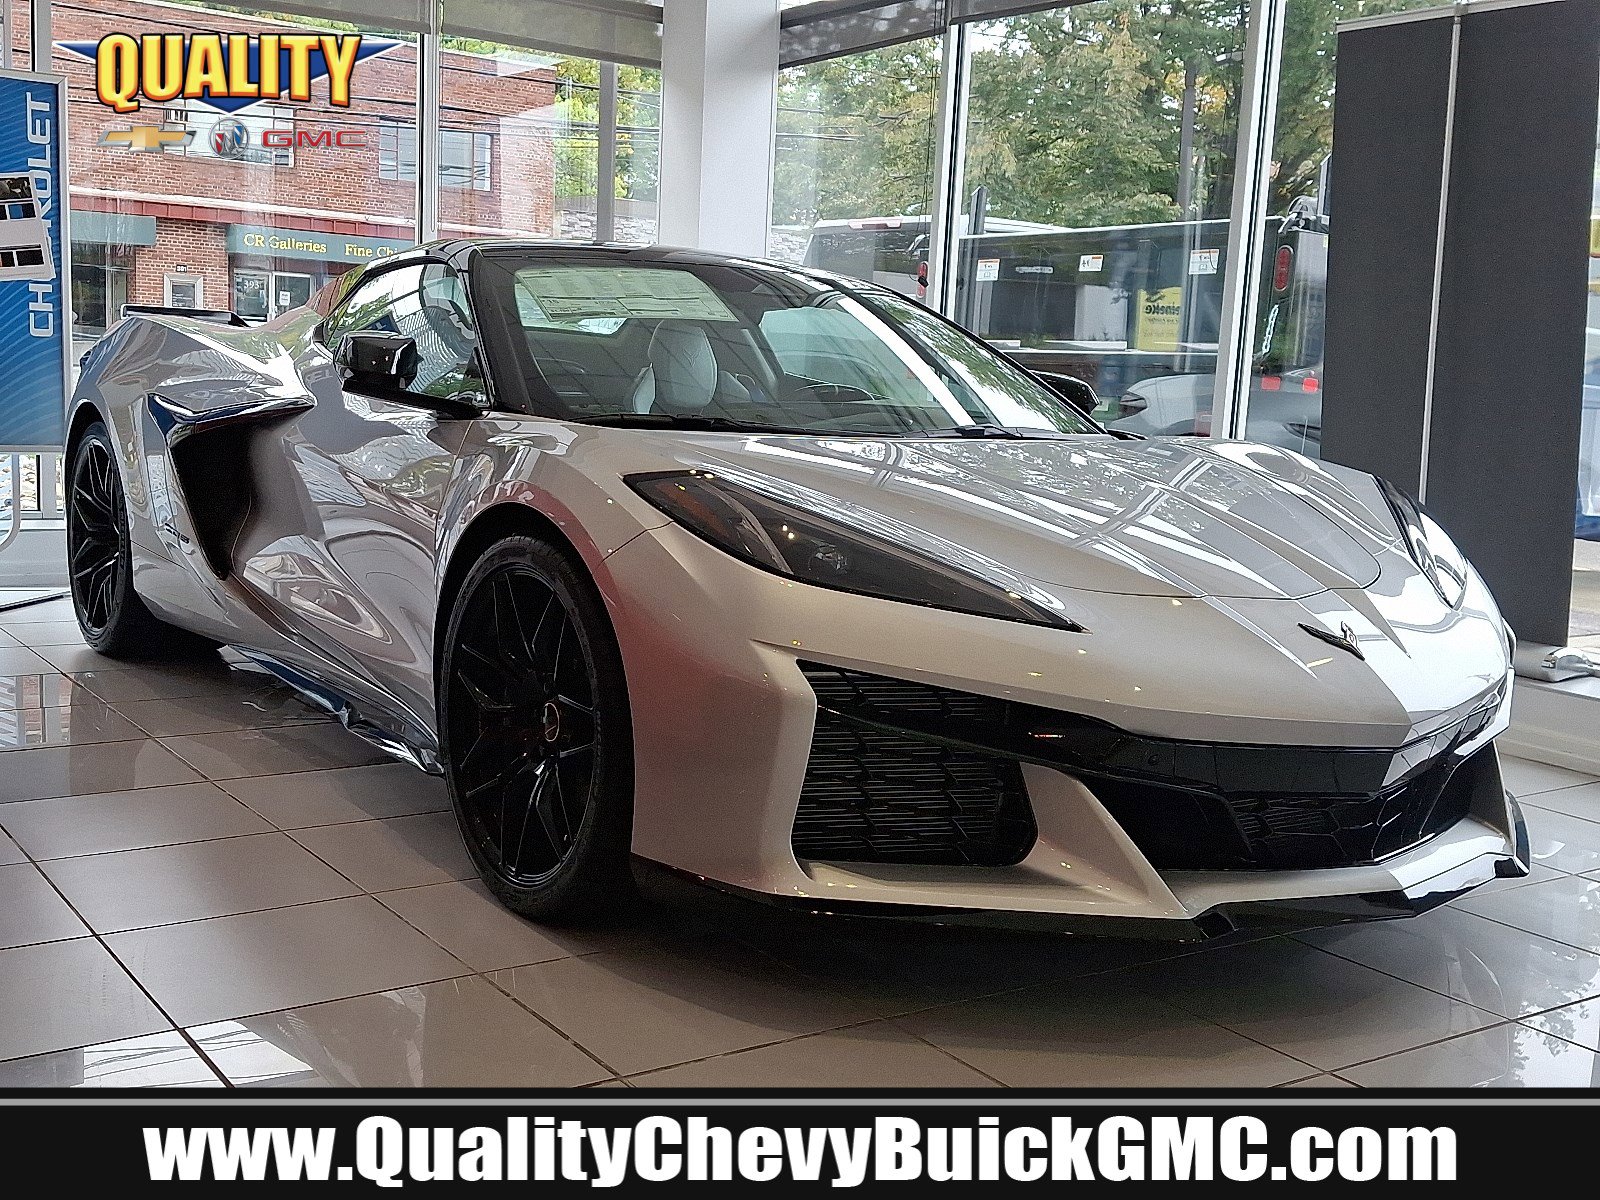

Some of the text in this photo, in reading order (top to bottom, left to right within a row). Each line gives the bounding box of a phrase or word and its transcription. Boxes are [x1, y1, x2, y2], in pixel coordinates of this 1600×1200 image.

[26, 92, 54, 337] CHOLET
[243, 233, 398, 257] CR Galleries Fine Chi
[243, 280, 260, 290] 393
